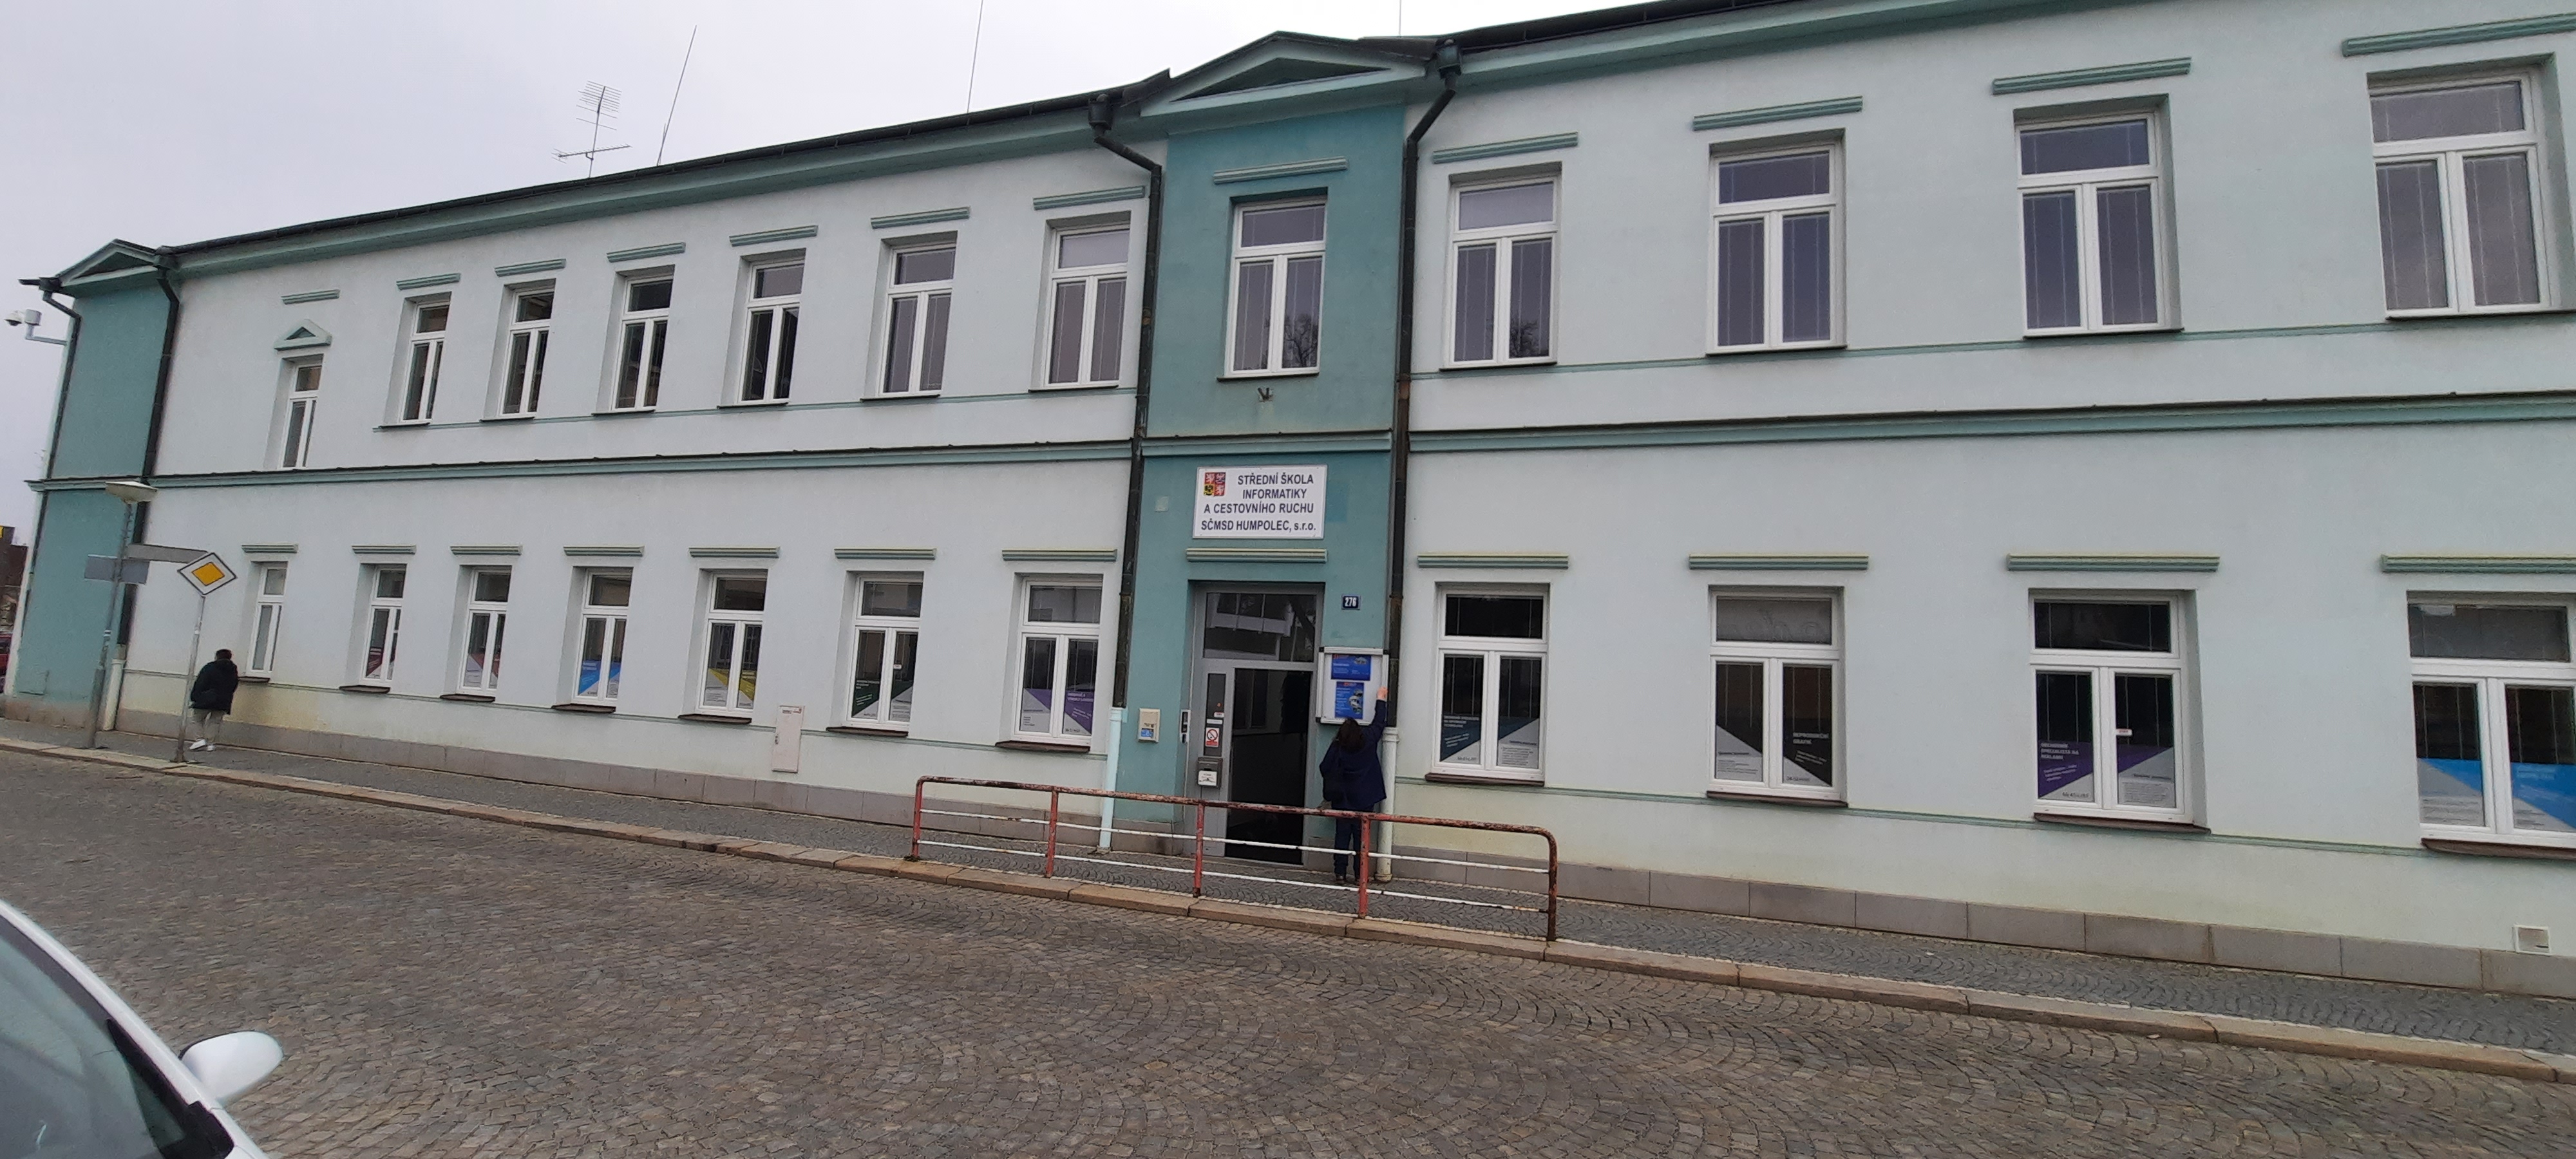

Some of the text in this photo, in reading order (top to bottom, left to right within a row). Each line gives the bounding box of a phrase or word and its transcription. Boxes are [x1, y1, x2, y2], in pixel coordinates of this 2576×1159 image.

[1237, 472, 1314, 485] STŘEDNÍ ŠKOLA
[1242, 489, 1307, 499] INFORMATIKY
[1204, 501, 1314, 514] A CESTOVNÍHO RUCHU
[1201, 518, 1316, 532] SČMSD HUMPOLEC, s.r.o.
[1345, 597, 1357, 607] 276
